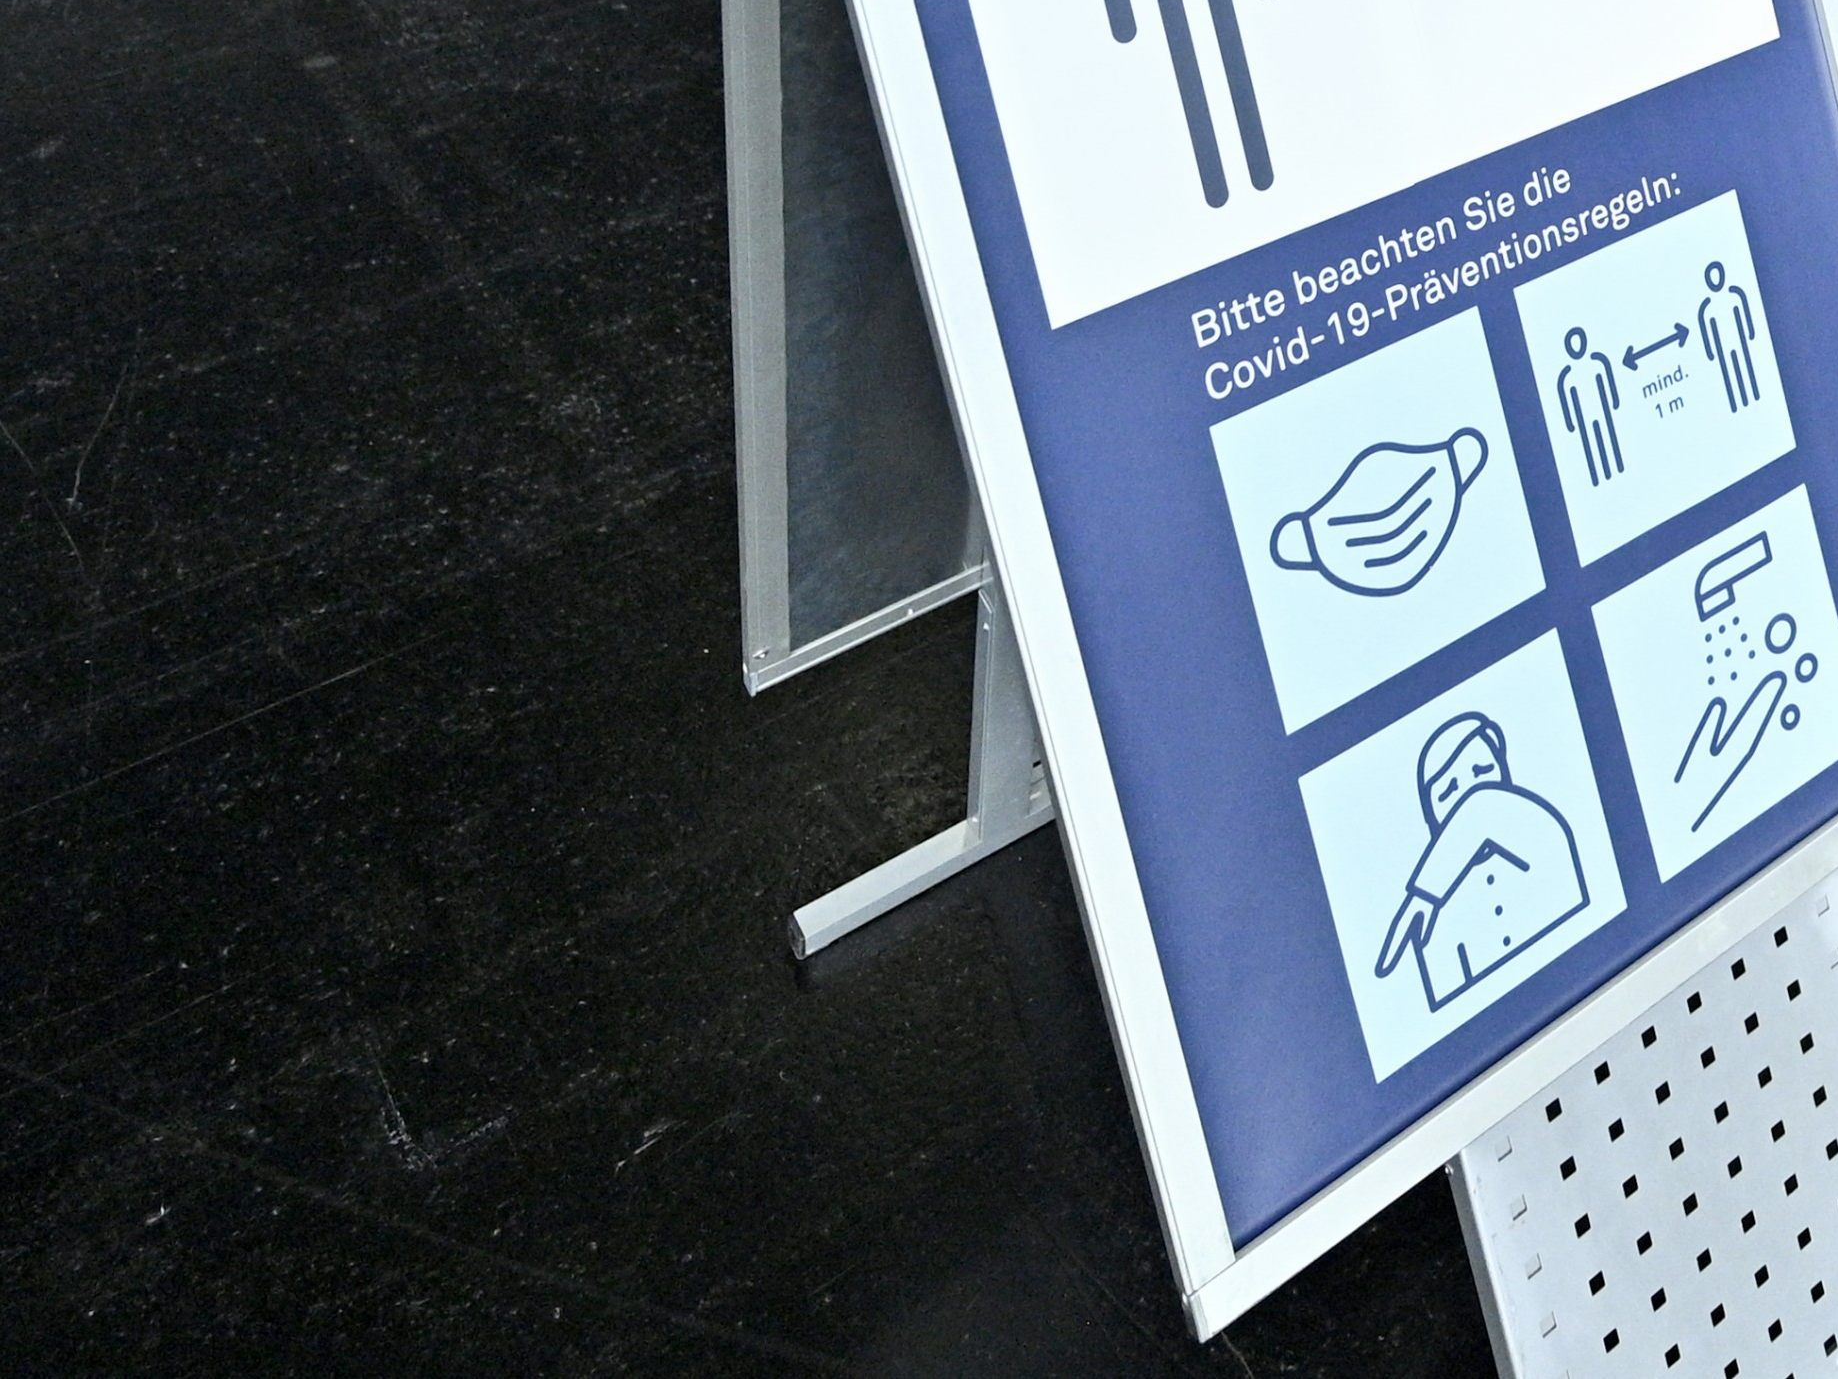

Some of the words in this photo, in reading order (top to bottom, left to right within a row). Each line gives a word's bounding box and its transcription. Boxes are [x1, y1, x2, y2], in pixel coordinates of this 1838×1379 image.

[1191, 288, 1286, 348] Bitte
[1292, 217, 1457, 305] beachten
[1462, 190, 1516, 231] Sie
[1523, 166, 1571, 207] die
[1204, 172, 1681, 400] Covid-19-Präventionsregeln:
[1642, 364, 1689, 399] mind.
[1655, 403, 1663, 419] 1
[1669, 396, 1684, 413] m
